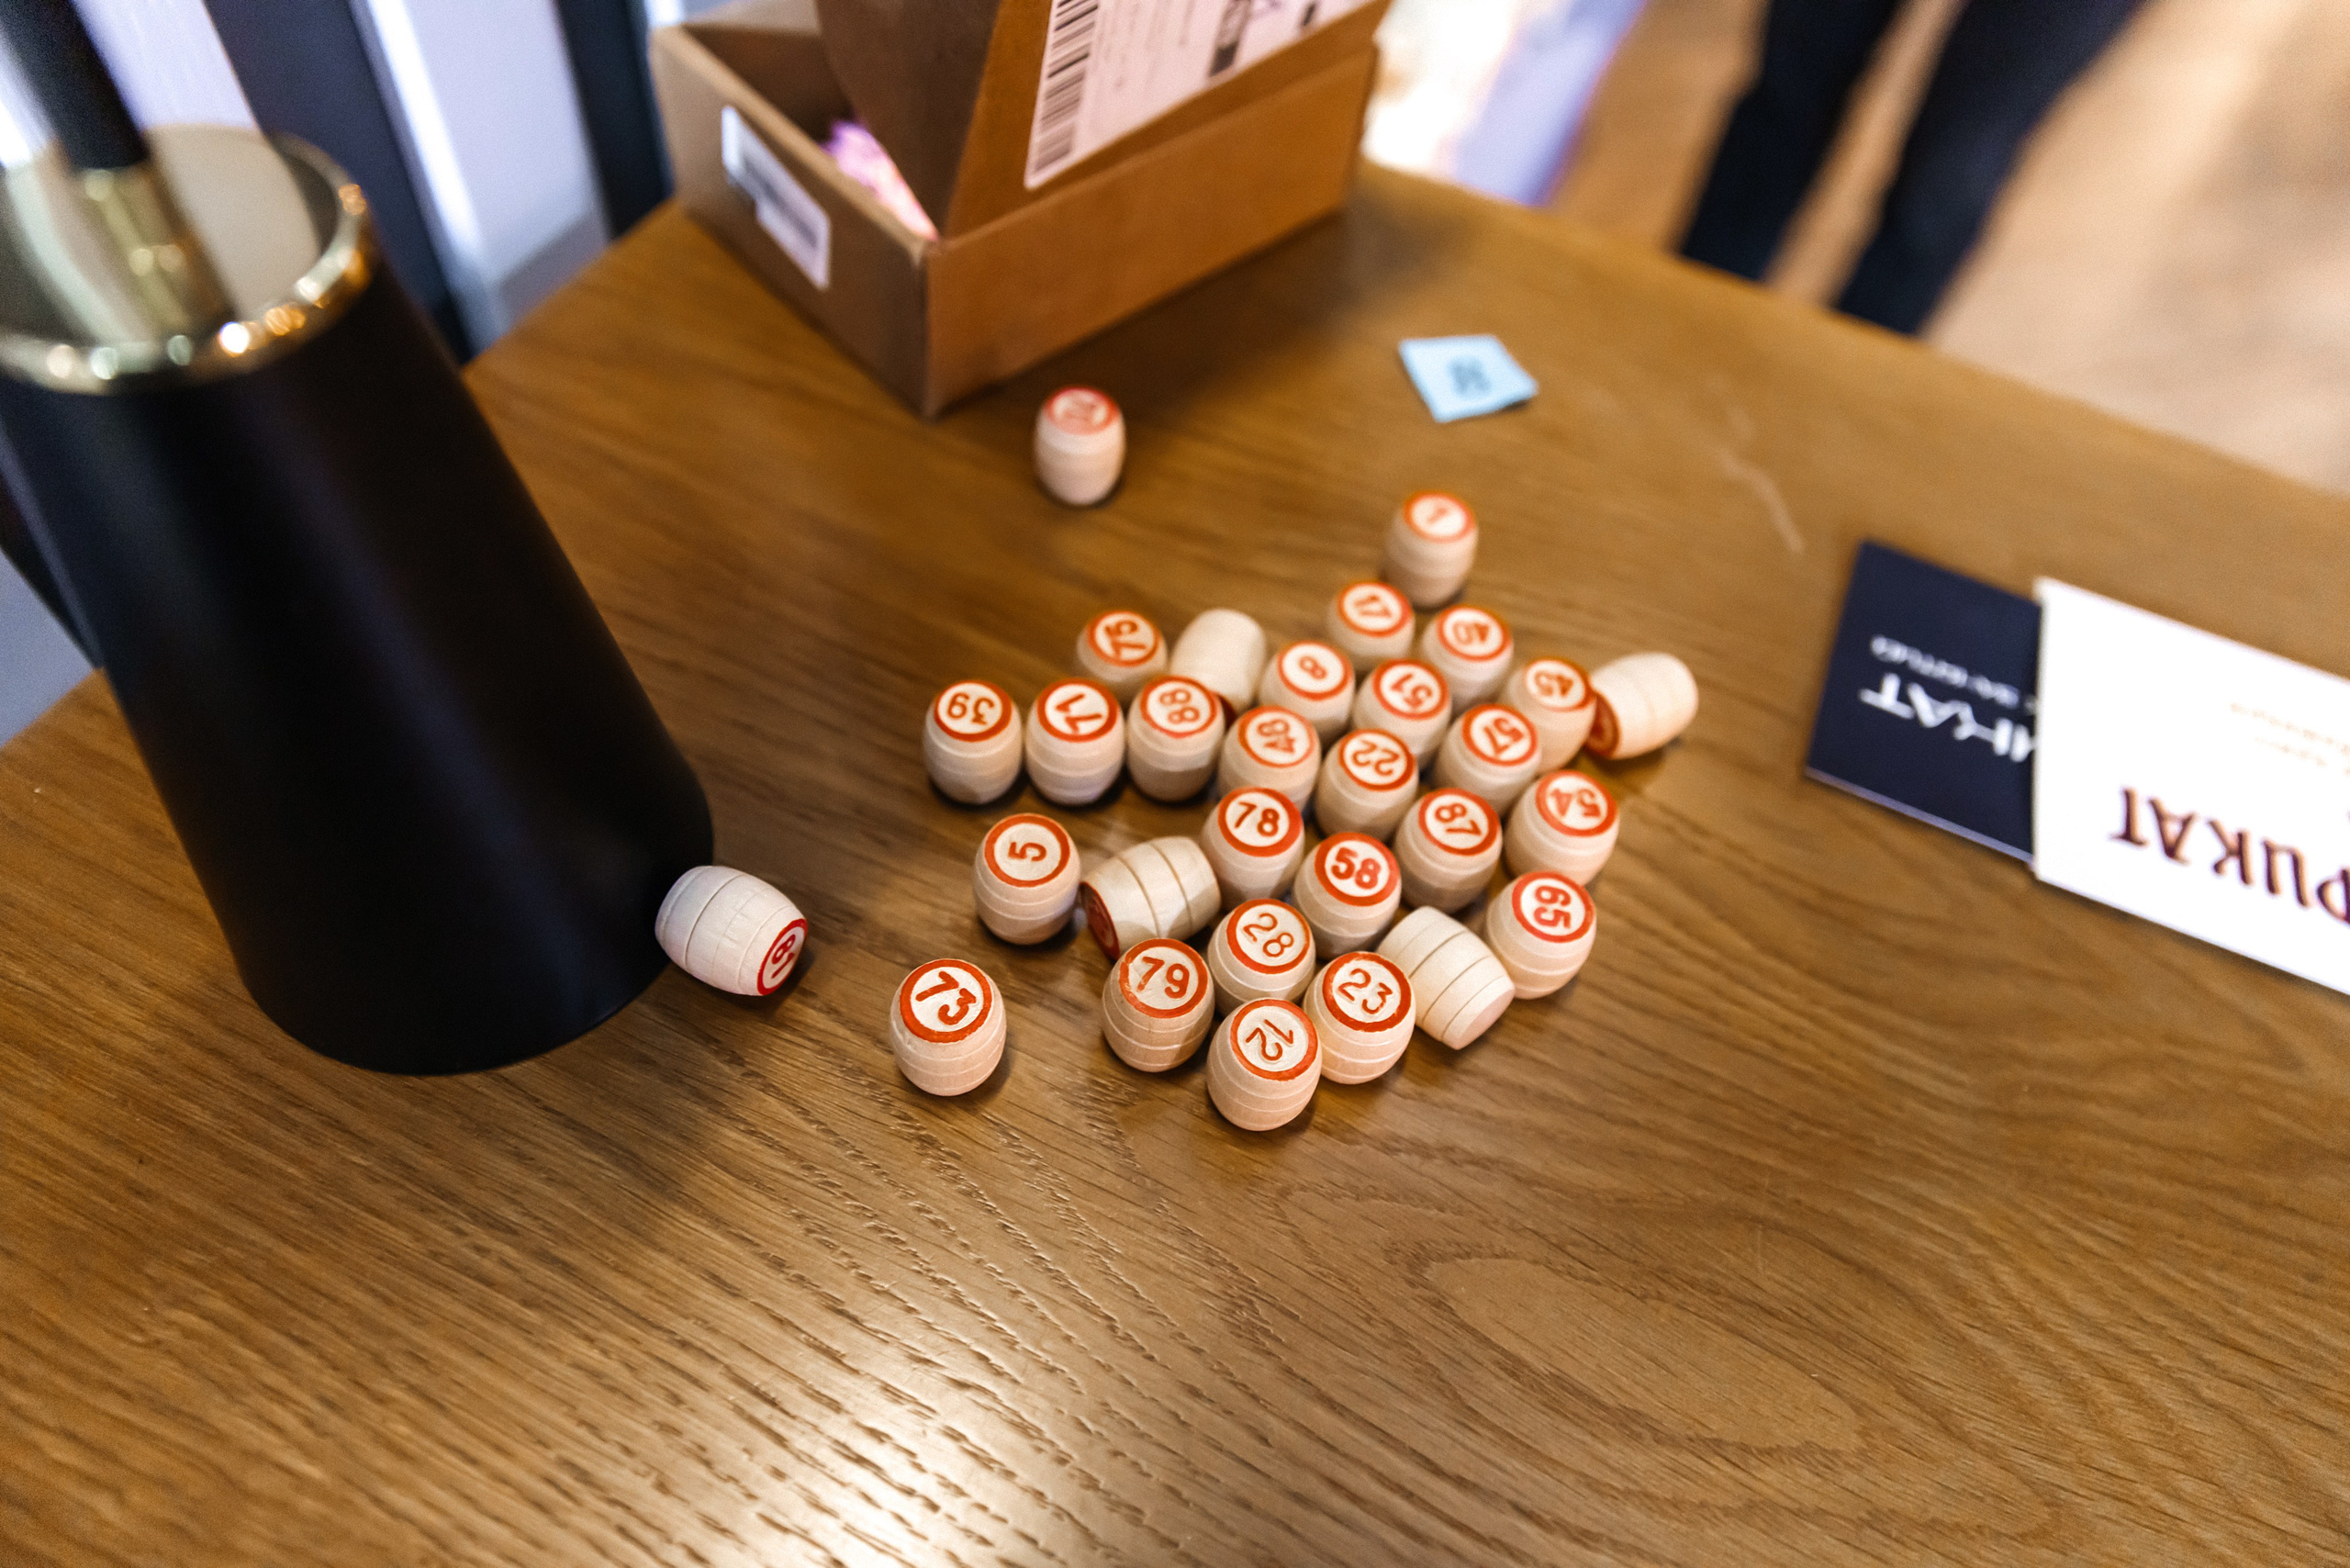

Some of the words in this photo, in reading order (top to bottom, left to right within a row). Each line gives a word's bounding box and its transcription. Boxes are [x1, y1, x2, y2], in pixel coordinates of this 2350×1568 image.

[1354, 594, 1392, 618] 17
[1104, 620, 1147, 658] 75
[1452, 621, 1490, 644] 40
[1299, 656, 1327, 680] 8
[1534, 670, 1574, 698] 45
[946, 692, 995, 725] 39
[1159, 689, 1200, 724] 88
[1391, 672, 1434, 710] 51
[1055, 693, 1103, 734] 71
[1257, 719, 1295, 754] 48
[1483, 716, 1526, 757] 57
[1351, 740, 1401, 777] 22
[1235, 801, 1280, 837] 78
[1435, 803, 1482, 836] 87
[1549, 789, 1603, 819] 54
[1008, 842, 1046, 862] 5
[1331, 847, 1381, 890] 58
[1534, 886, 1571, 928] 65
[1243, 913, 1294, 958] 28
[771, 935, 796, 979] 81
[1137, 957, 1190, 999] 79
[1337, 969, 1393, 1014] 23
[916, 971, 977, 1025] 73
[1245, 1020, 1293, 1061] 12
